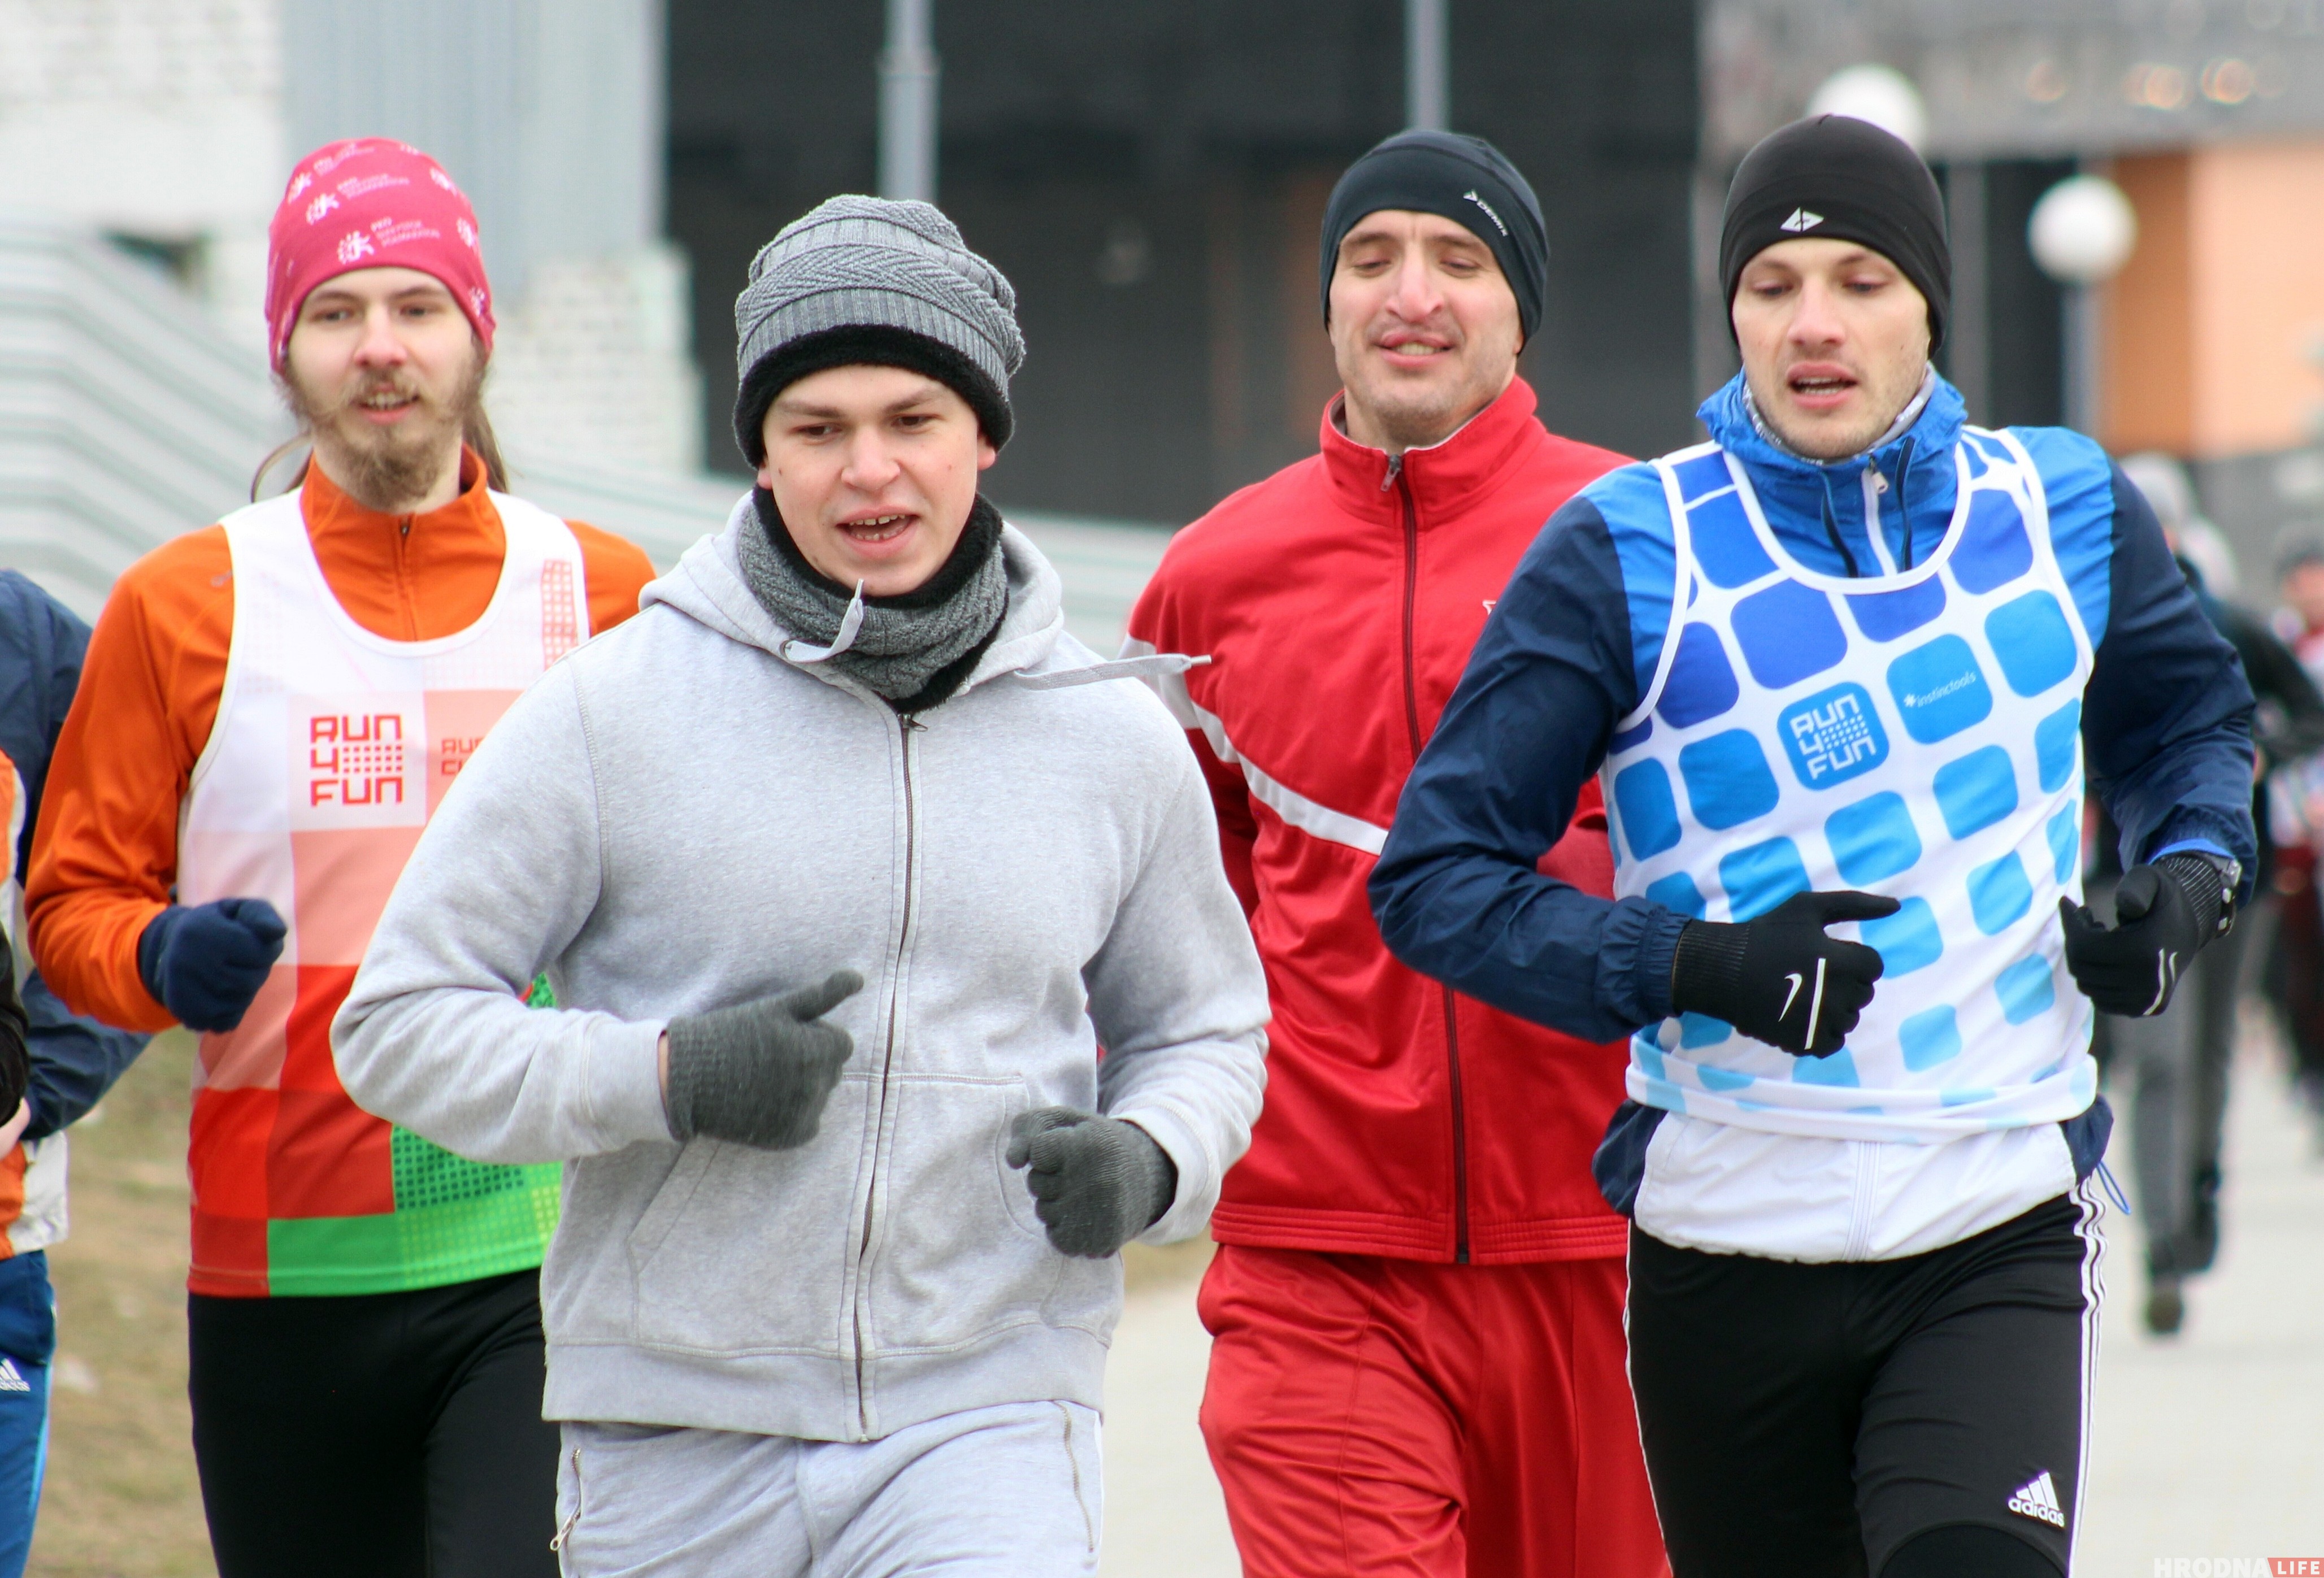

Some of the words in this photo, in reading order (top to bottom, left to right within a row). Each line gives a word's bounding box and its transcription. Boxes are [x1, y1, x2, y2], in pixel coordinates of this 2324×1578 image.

[1476, 199, 1508, 236] DEMIX
[311, 715, 402, 743] RUN
[1789, 693, 1860, 740] RUN
[311, 747, 338, 773] 4
[1807, 735, 1877, 780] FUN
[311, 776, 403, 807] FUN
[2008, 1498, 2065, 1528] adidas
